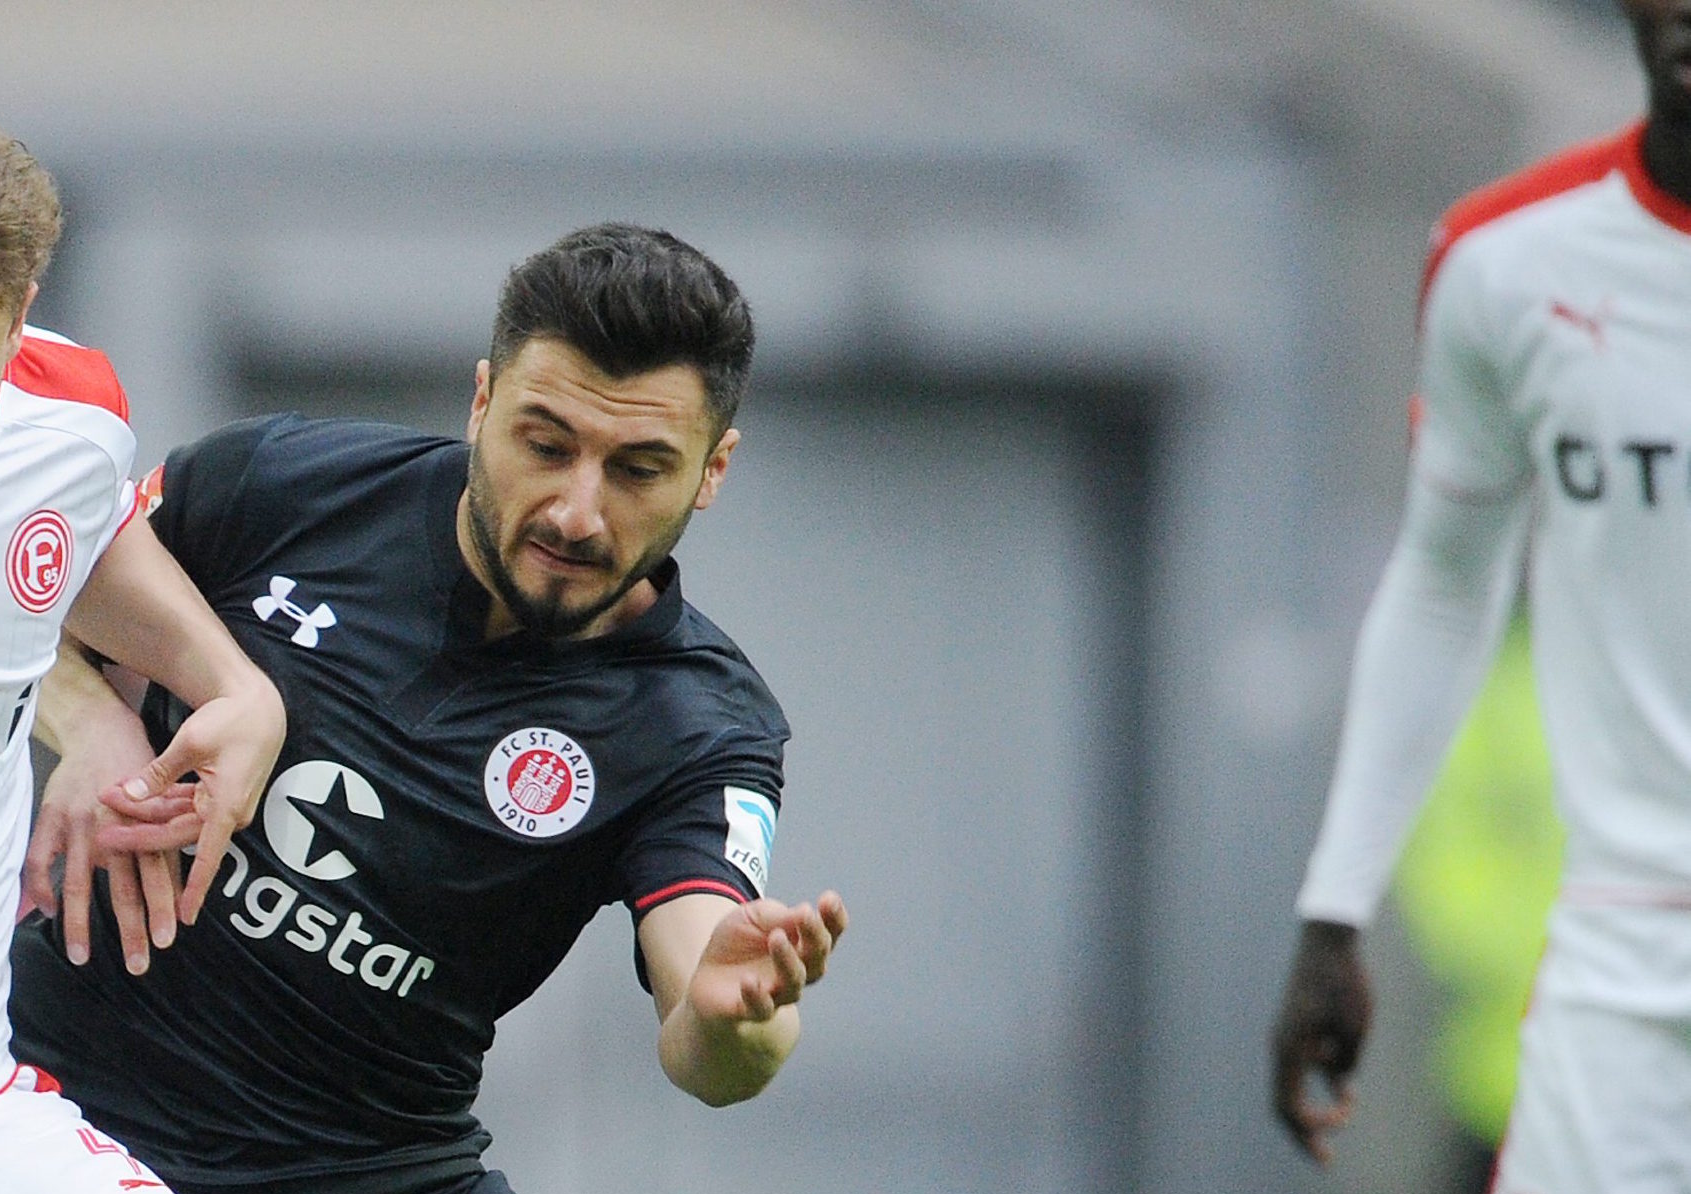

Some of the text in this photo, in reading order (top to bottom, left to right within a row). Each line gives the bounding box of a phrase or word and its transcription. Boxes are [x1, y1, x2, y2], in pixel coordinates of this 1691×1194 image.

[501, 731, 590, 804] FC ST. PAULI
[498, 802, 537, 832] 1910
[182, 839, 435, 998] ngstar
